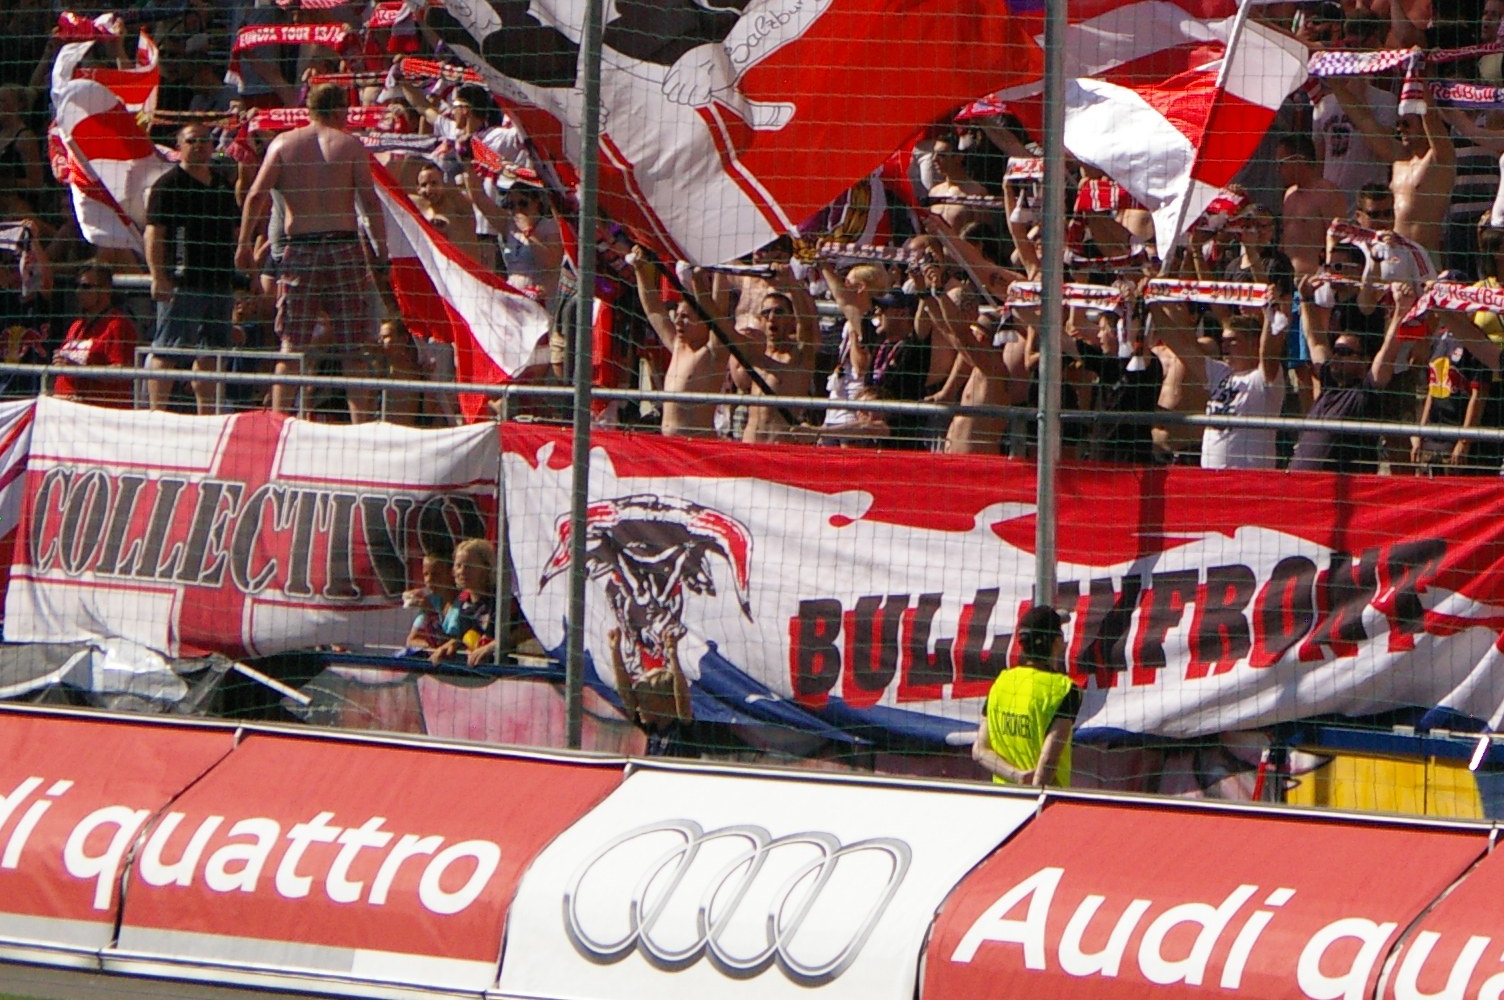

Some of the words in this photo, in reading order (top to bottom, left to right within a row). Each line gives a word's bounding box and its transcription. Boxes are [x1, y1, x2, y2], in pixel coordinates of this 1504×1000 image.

[790, 539, 1448, 707] BULLNFRONT
[62, 804, 502, 915] quattro
[949, 864, 1297, 991] Audi
